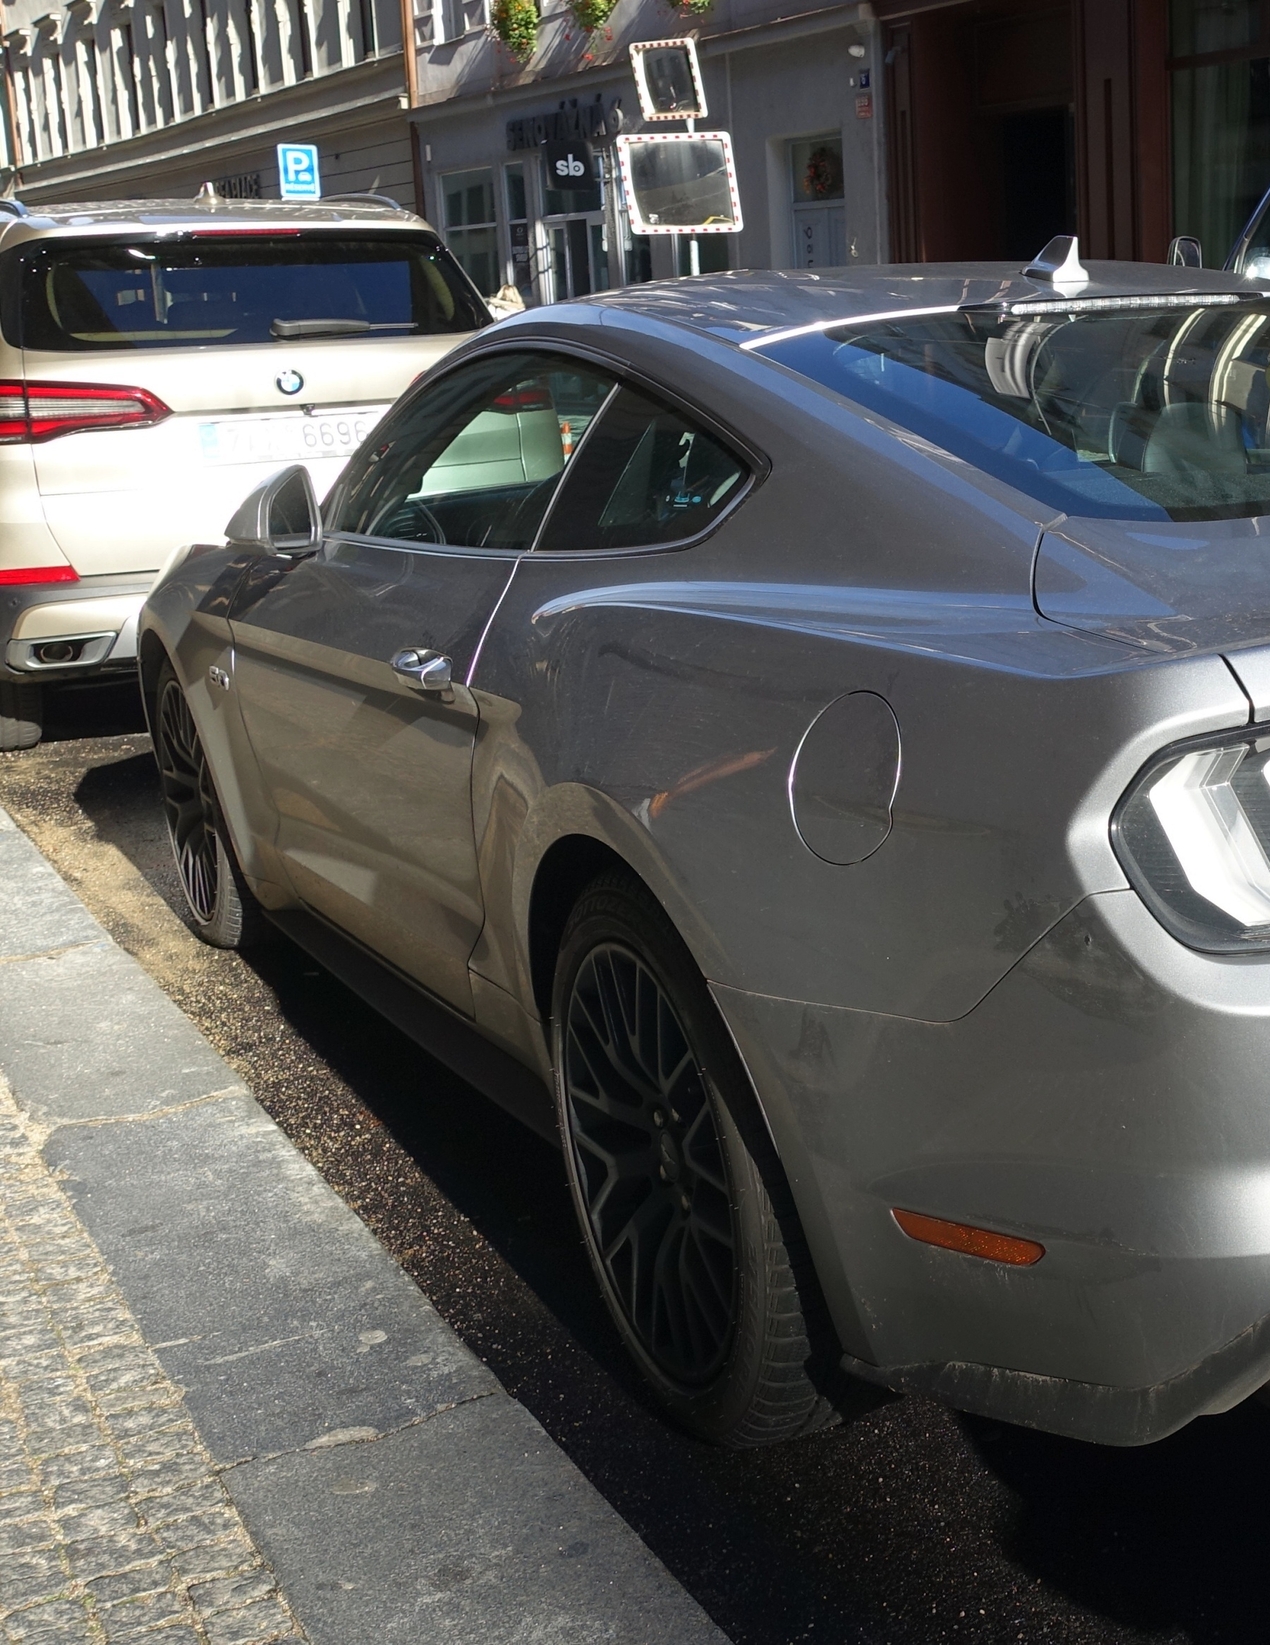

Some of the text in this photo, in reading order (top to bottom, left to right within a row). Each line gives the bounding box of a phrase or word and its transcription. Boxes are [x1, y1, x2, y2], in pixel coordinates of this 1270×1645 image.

[286, 151, 310, 181] P
[555, 153, 585, 177] sb
[302, 421, 368, 447] 6696
